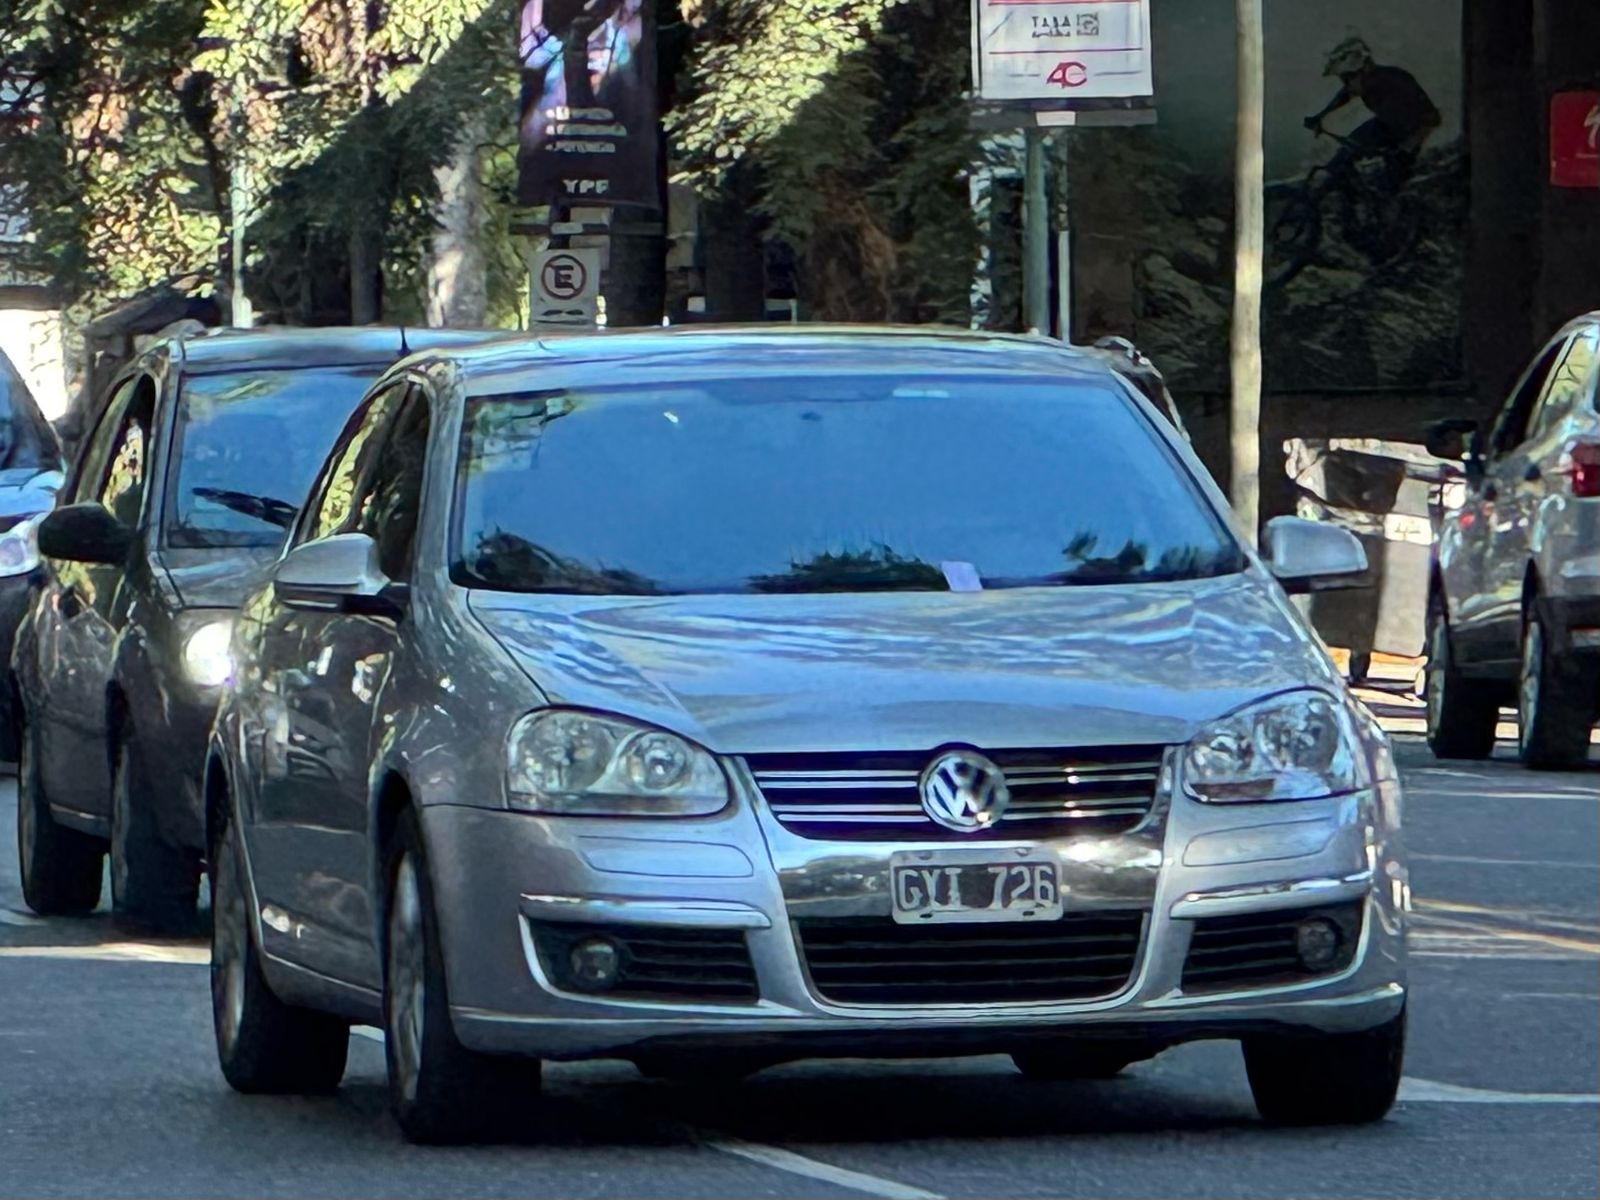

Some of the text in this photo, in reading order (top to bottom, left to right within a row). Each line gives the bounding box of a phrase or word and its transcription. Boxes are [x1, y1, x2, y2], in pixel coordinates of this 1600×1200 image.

[562, 179, 609, 194] YPF
[554, 265, 574, 289] E
[987, 865, 1055, 910] 726
